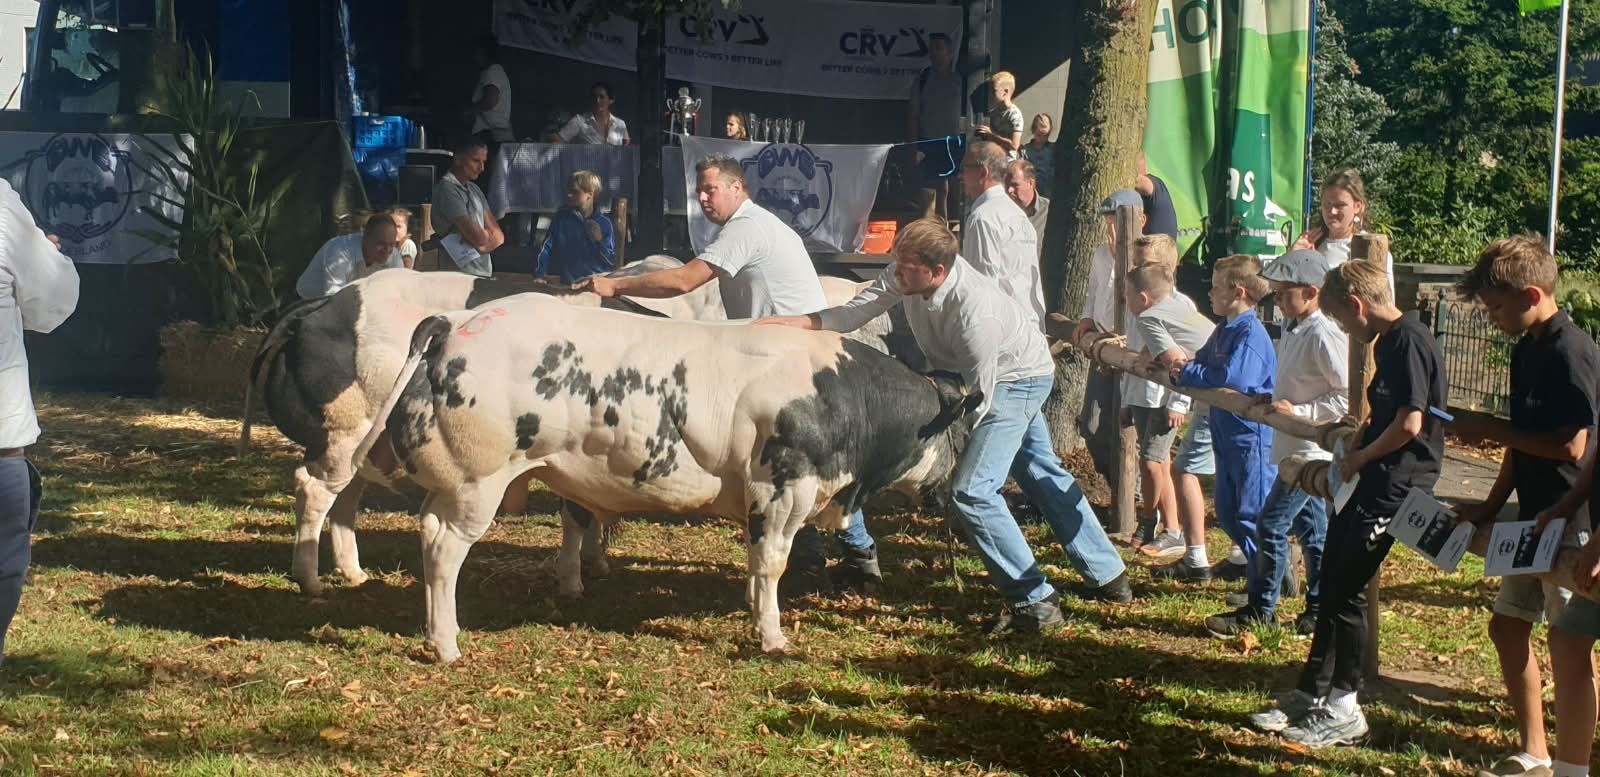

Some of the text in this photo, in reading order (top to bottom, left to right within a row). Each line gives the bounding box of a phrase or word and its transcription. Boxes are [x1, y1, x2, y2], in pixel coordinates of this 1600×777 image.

[839, 31, 898, 57] CRV
[730, 54, 763, 65] BETTER
[821, 63, 853, 73] BETTER
